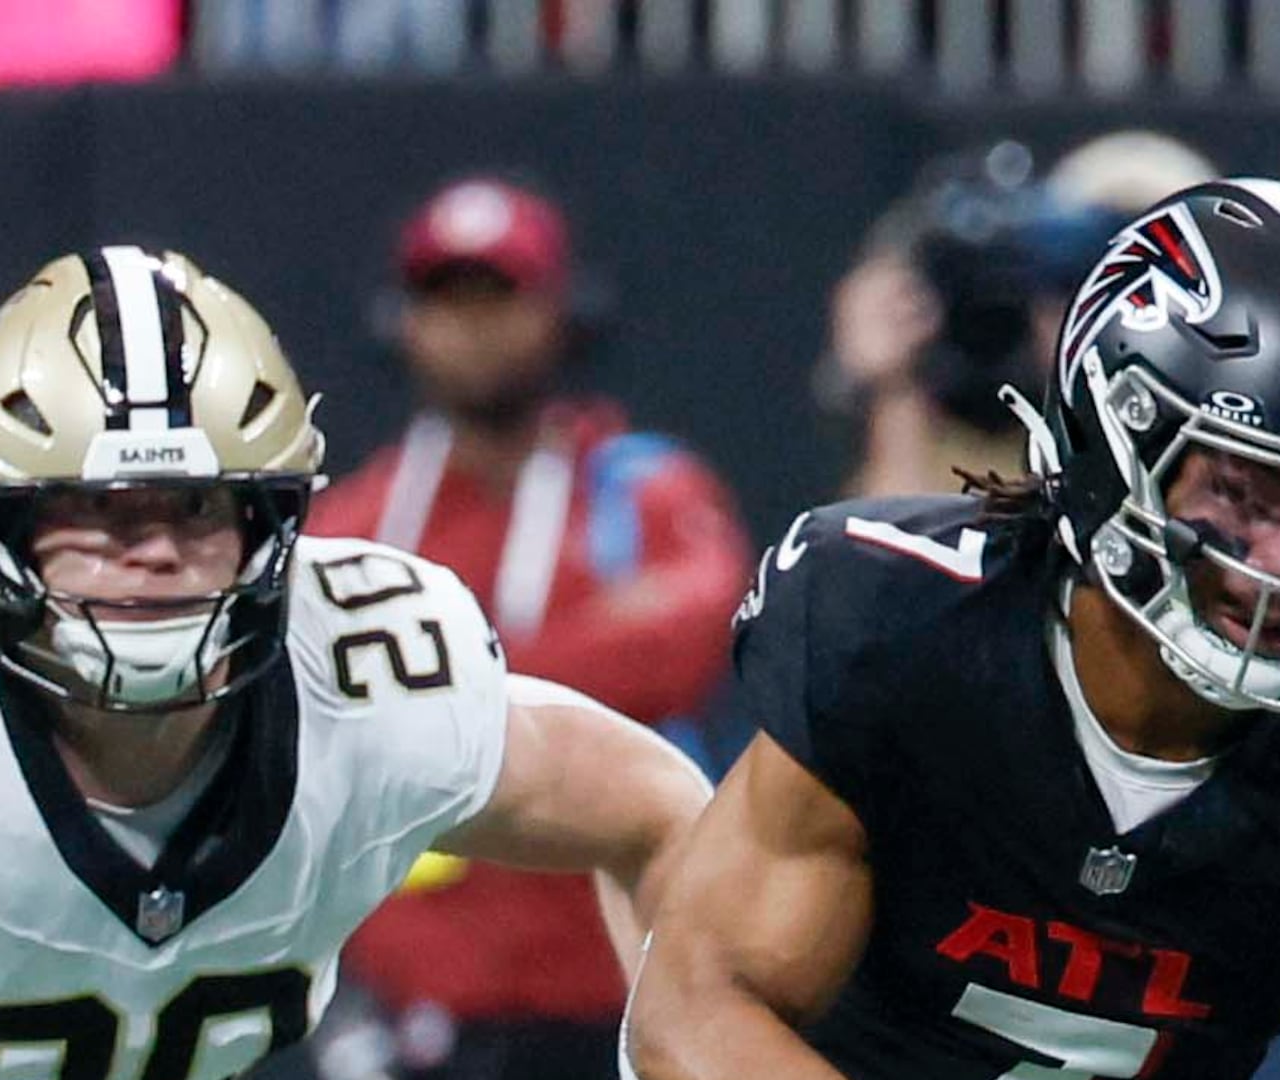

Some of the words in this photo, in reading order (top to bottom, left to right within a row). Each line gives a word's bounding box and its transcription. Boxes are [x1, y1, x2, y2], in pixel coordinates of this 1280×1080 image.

[120, 447, 184, 463] SAINTS
[844, 515, 988, 584] 7
[312, 554, 454, 698] 20
[935, 900, 1215, 1018] ATL
